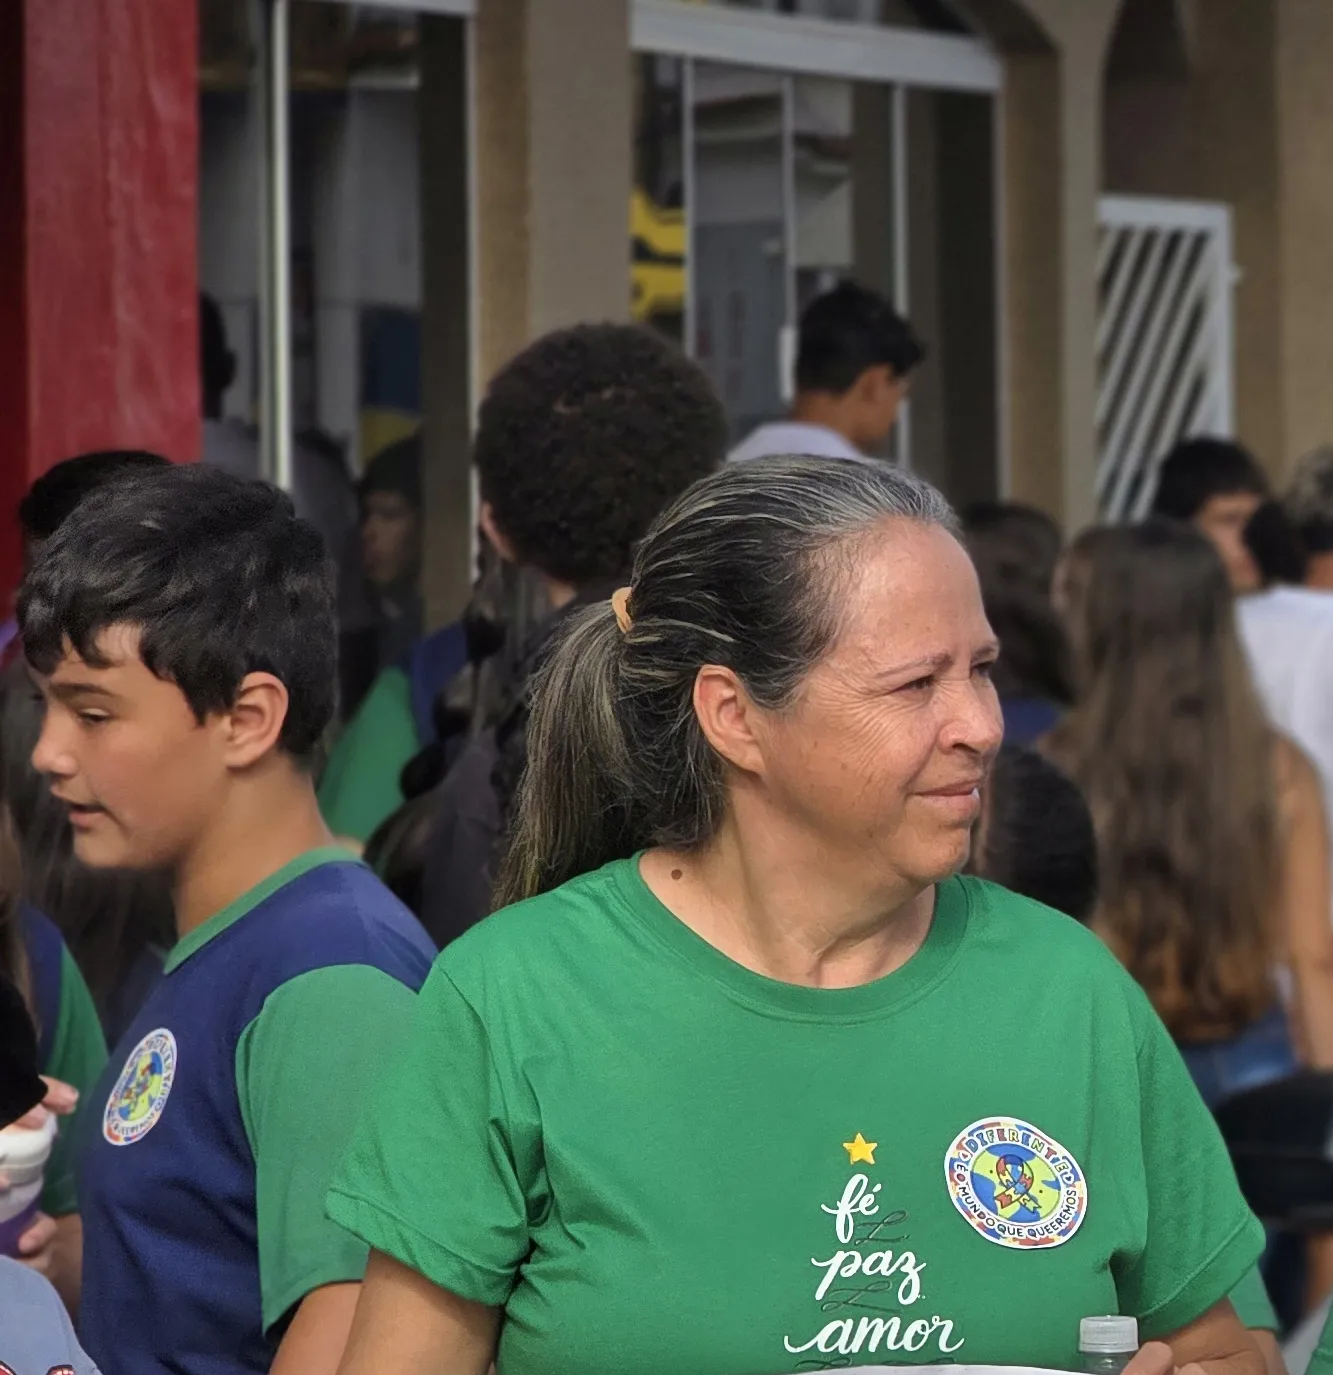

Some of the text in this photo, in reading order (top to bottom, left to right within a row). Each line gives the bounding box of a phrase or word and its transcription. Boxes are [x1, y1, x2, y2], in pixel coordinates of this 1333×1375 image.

[965, 1128, 1069, 1172] DIFERENTE
[821, 1173, 882, 1244] fé
[959, 1186, 996, 1227] MUNDO
[997, 1223, 1024, 1238] QUE
[1027, 1189, 1077, 1239] QUEEREMOS
[811, 1251, 927, 1306] paz
[784, 1315, 965, 1354] amor
